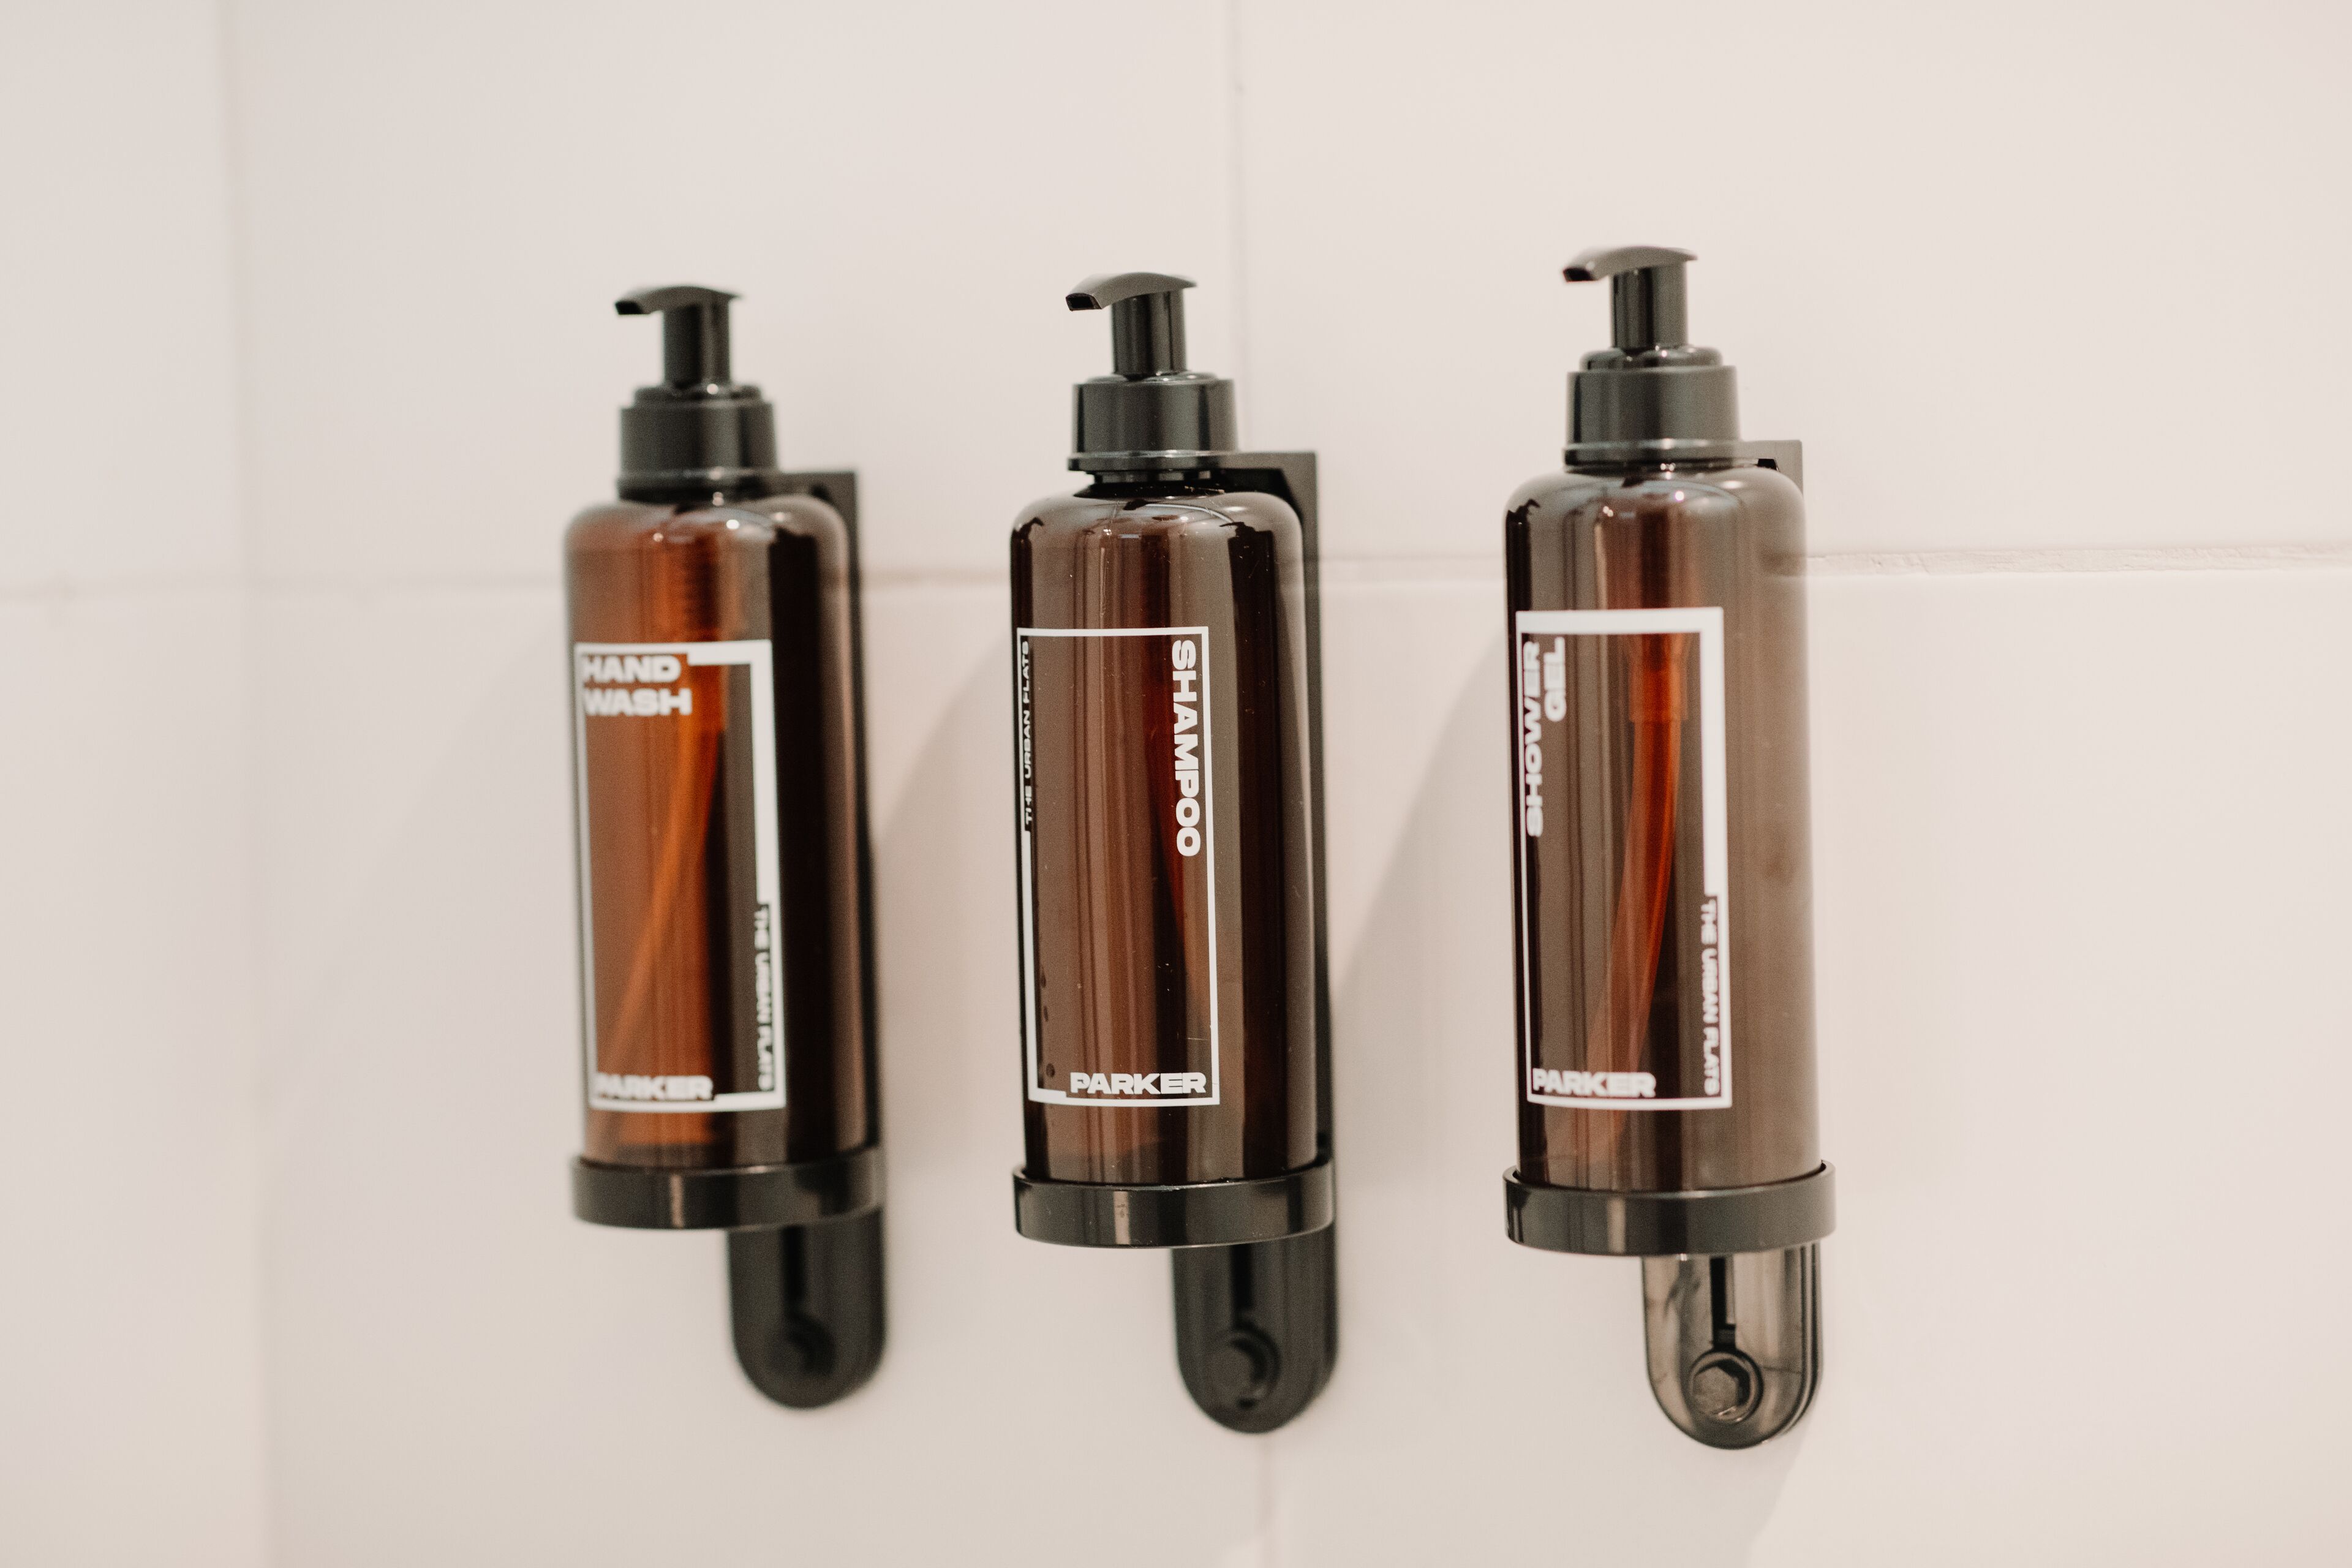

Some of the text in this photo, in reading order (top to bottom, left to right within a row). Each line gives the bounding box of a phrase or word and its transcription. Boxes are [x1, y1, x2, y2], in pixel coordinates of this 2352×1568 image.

[581, 655, 681, 683] HAND
[1022, 641, 1030, 703] FLATS
[1544, 636, 1566, 722] GEL
[584, 688, 692, 715] WASH
[1023, 710, 1031, 778] URBAN
[1172, 639, 1201, 857] SHAMPOO
[1523, 641, 1544, 837] SHOWER
[1701, 899, 1720, 1095] THE URBAN FLATS
[595, 1072, 713, 1101] PARKER
[1070, 1072, 1207, 1095] PARKER
[1532, 1068, 1656, 1098] PARKER
